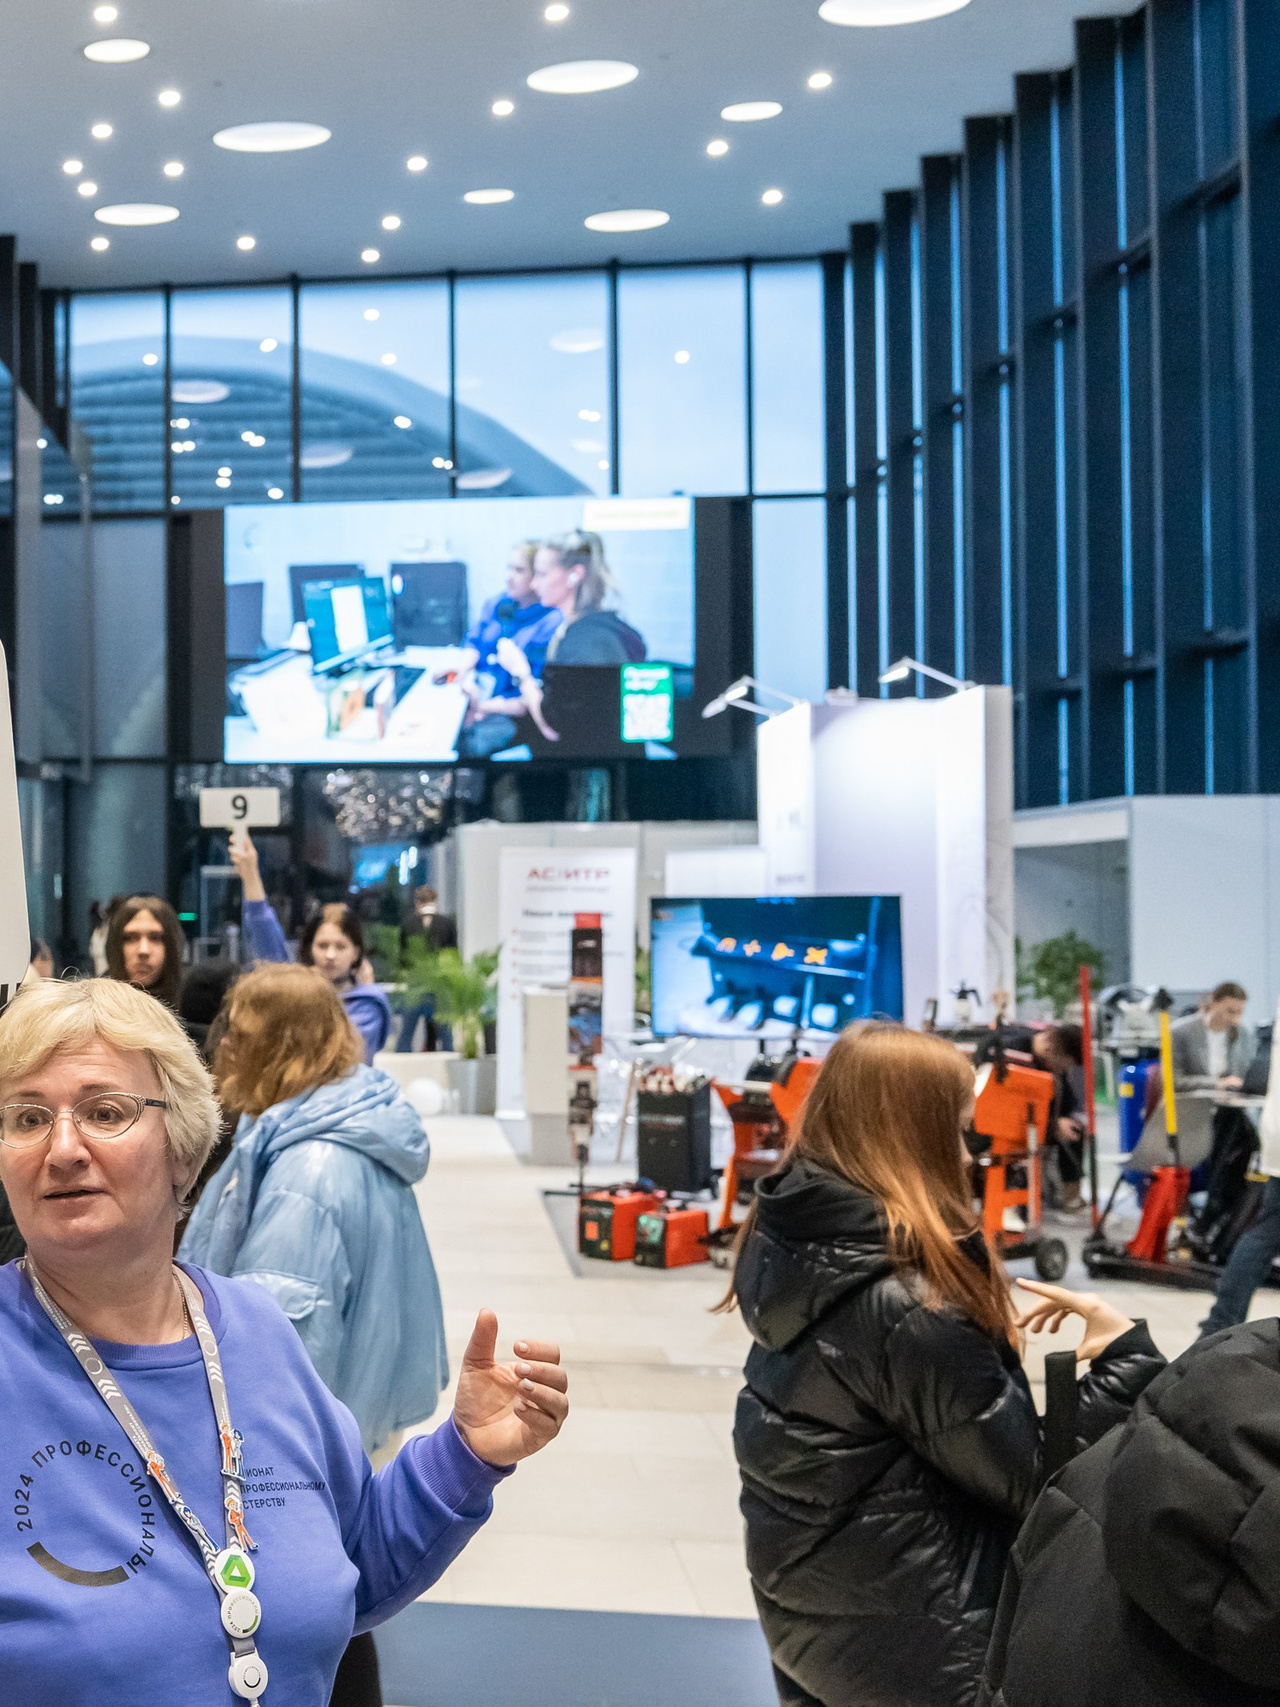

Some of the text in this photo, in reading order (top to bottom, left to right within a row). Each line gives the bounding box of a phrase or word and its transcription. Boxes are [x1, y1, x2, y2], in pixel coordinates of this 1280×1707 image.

[232, 794, 248, 820] 9
[245, 1467, 274, 1478] ИОНАТ
[14, 1439, 156, 1575] 2024 ПРОФЕССИОНАЛЫ
[242, 1498, 286, 1510] СТЕРСТВУ
